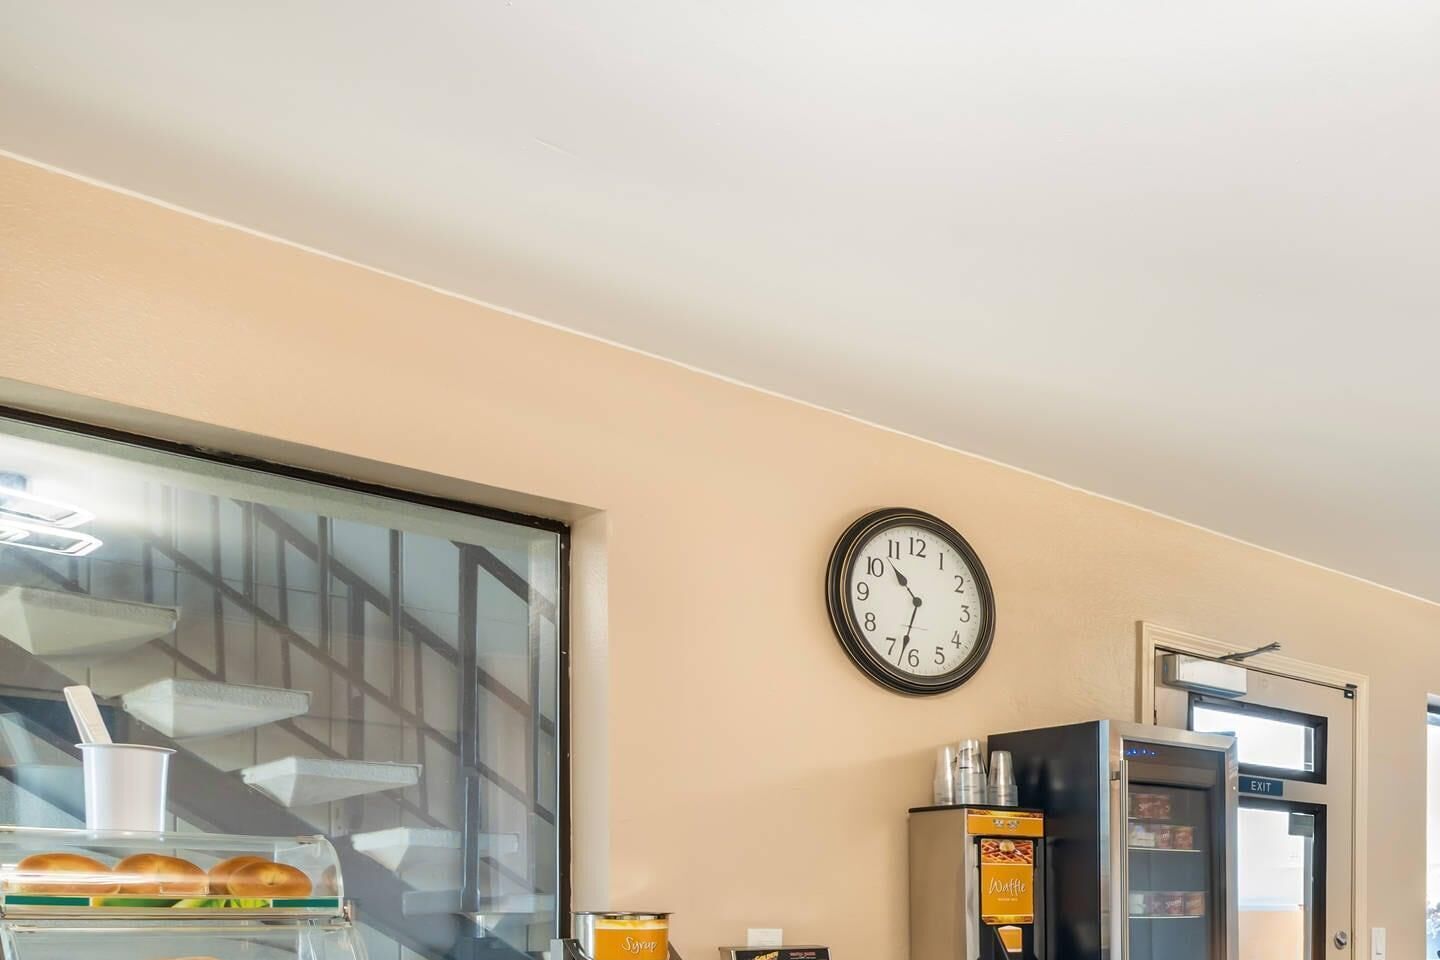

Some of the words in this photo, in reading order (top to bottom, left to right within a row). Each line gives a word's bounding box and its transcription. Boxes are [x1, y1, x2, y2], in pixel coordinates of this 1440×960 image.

[888, 539, 900, 560] 11
[909, 536, 926, 558] 12
[866, 556, 884, 578] 10
[938, 552, 944, 571] 1
[856, 581, 870, 601] 9
[954, 575, 964, 594] 2
[864, 612, 876, 632] 8
[959, 604, 970, 623] 3
[885, 637, 897, 656] 7
[951, 630, 962, 649] 4
[907, 648, 920, 668] 6
[934, 646, 945, 665] 5
[1251, 780, 1272, 793] EXIT
[988, 876, 1026, 897] Waffle
[621, 936, 657, 954] Syrup
